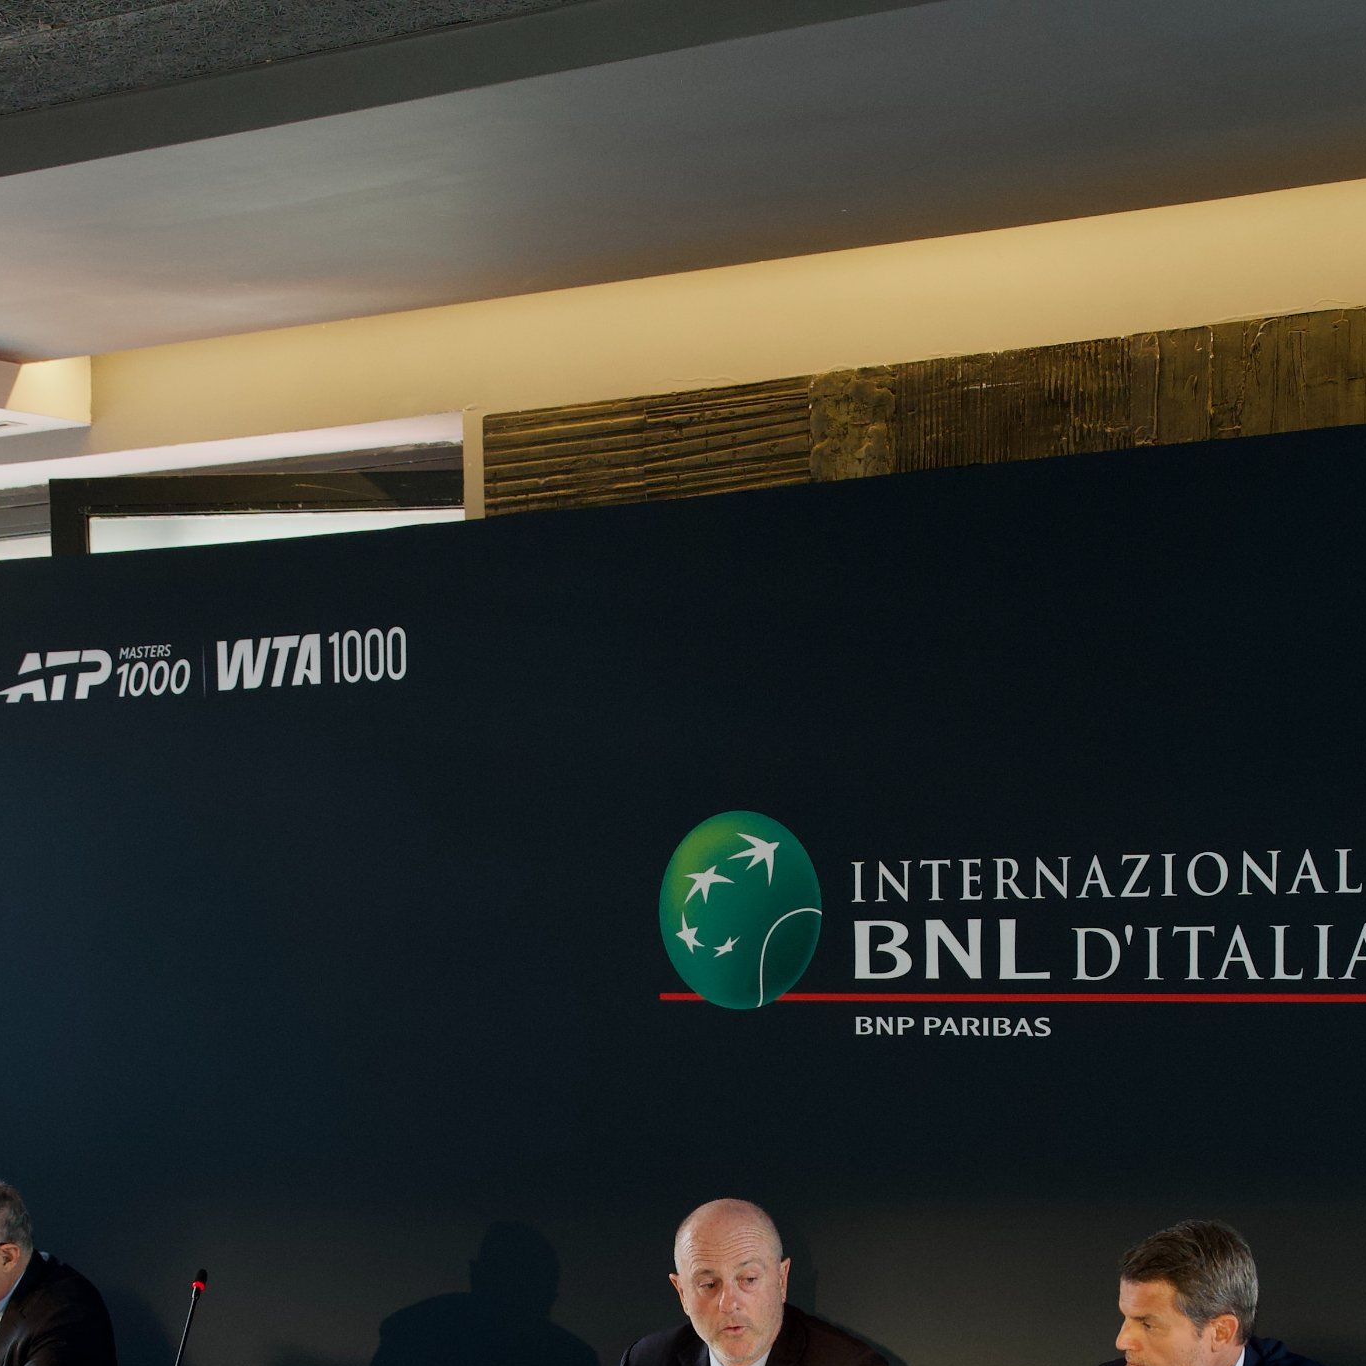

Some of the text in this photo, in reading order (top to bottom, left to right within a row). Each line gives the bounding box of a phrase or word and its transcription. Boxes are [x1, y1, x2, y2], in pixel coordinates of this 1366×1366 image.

[116, 658, 191, 698] 1000
[216, 633, 322, 691] WTA
[328, 626, 406, 683] 1000
[119, 644, 172, 660] MASTERS
[854, 919, 1051, 980] BNL
[855, 1016, 1052, 1037] BNP PARIBAS
